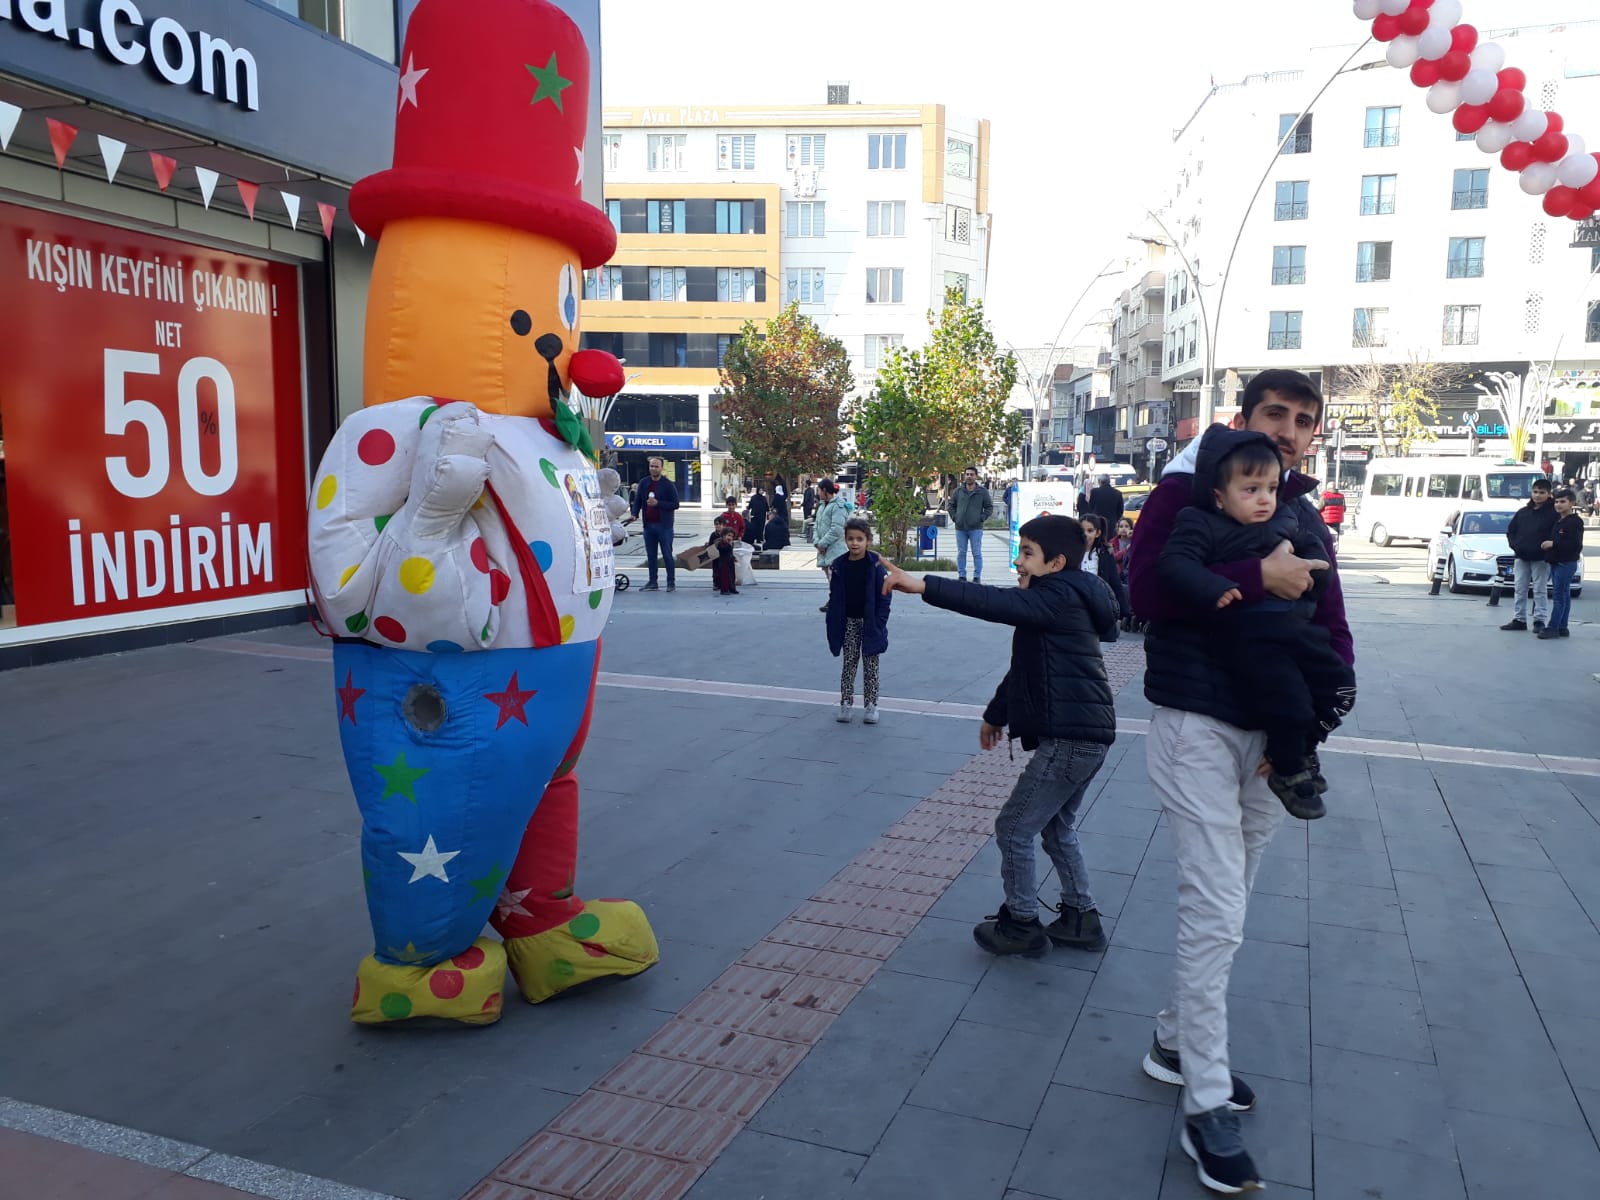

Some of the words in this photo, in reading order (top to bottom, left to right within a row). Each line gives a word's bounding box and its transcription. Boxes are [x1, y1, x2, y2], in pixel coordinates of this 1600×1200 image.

[679, 105, 720, 126] PLAZA
[25, 238, 94, 293] KIŞIN
[99, 248, 184, 305] KEYFİNİ
[154, 319, 183, 348] NET
[102, 346, 240, 500] 50
[626, 437, 666, 447] TURKCELL
[66, 510, 274, 607] İNDİRİM
